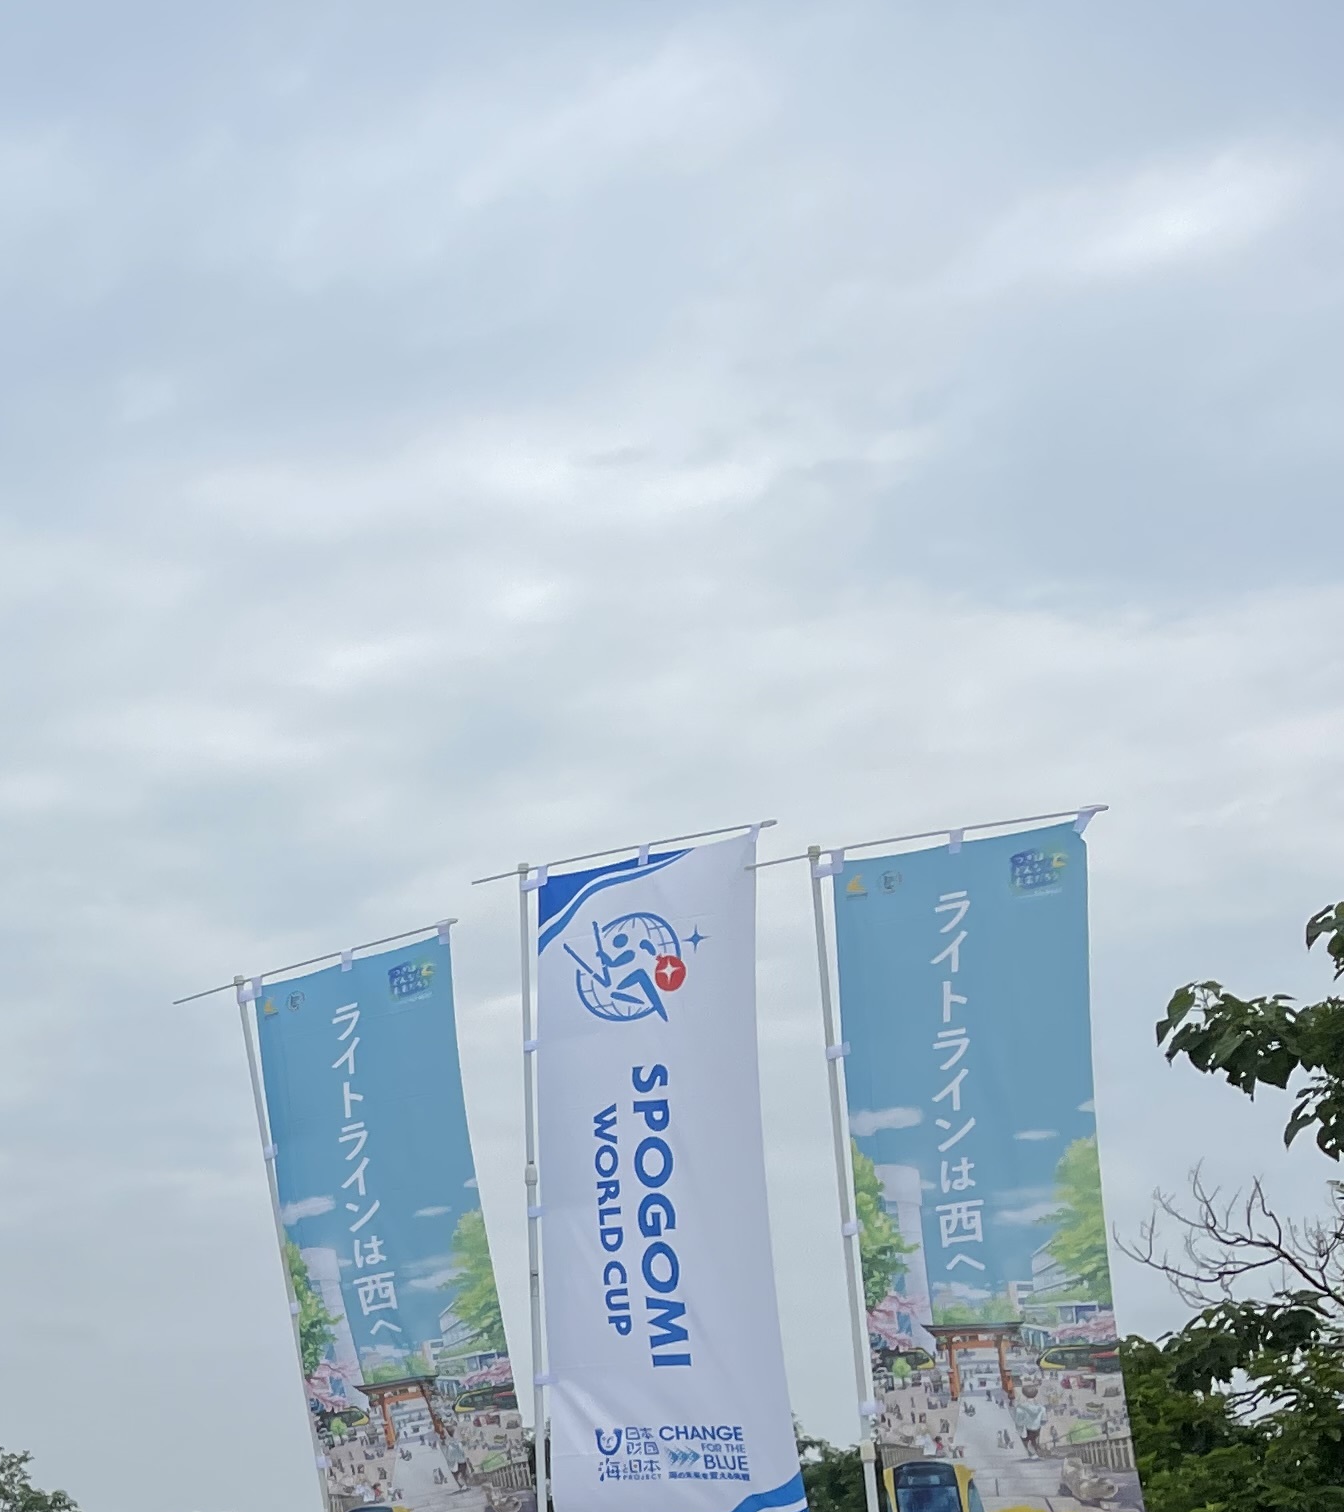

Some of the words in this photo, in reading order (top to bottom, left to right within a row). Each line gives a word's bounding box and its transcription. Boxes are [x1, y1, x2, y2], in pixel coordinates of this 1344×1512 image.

[930, 887, 985, 1273] ライトラインは西へ
[330, 1001, 402, 1337] ライトラインは西へ
[593, 1102, 624, 1253] WORLD
[631, 1063, 692, 1368] SPOGOMI
[603, 1260, 632, 1337] CUP
[625, 1426, 654, 1440] 日本
[659, 1425, 744, 1441] CHANGE
[701, 1443, 722, 1453] FOR
[726, 1443, 746, 1454] THE
[598, 1457, 661, 1482] 海と日本
[704, 1454, 750, 1471] BLUE
